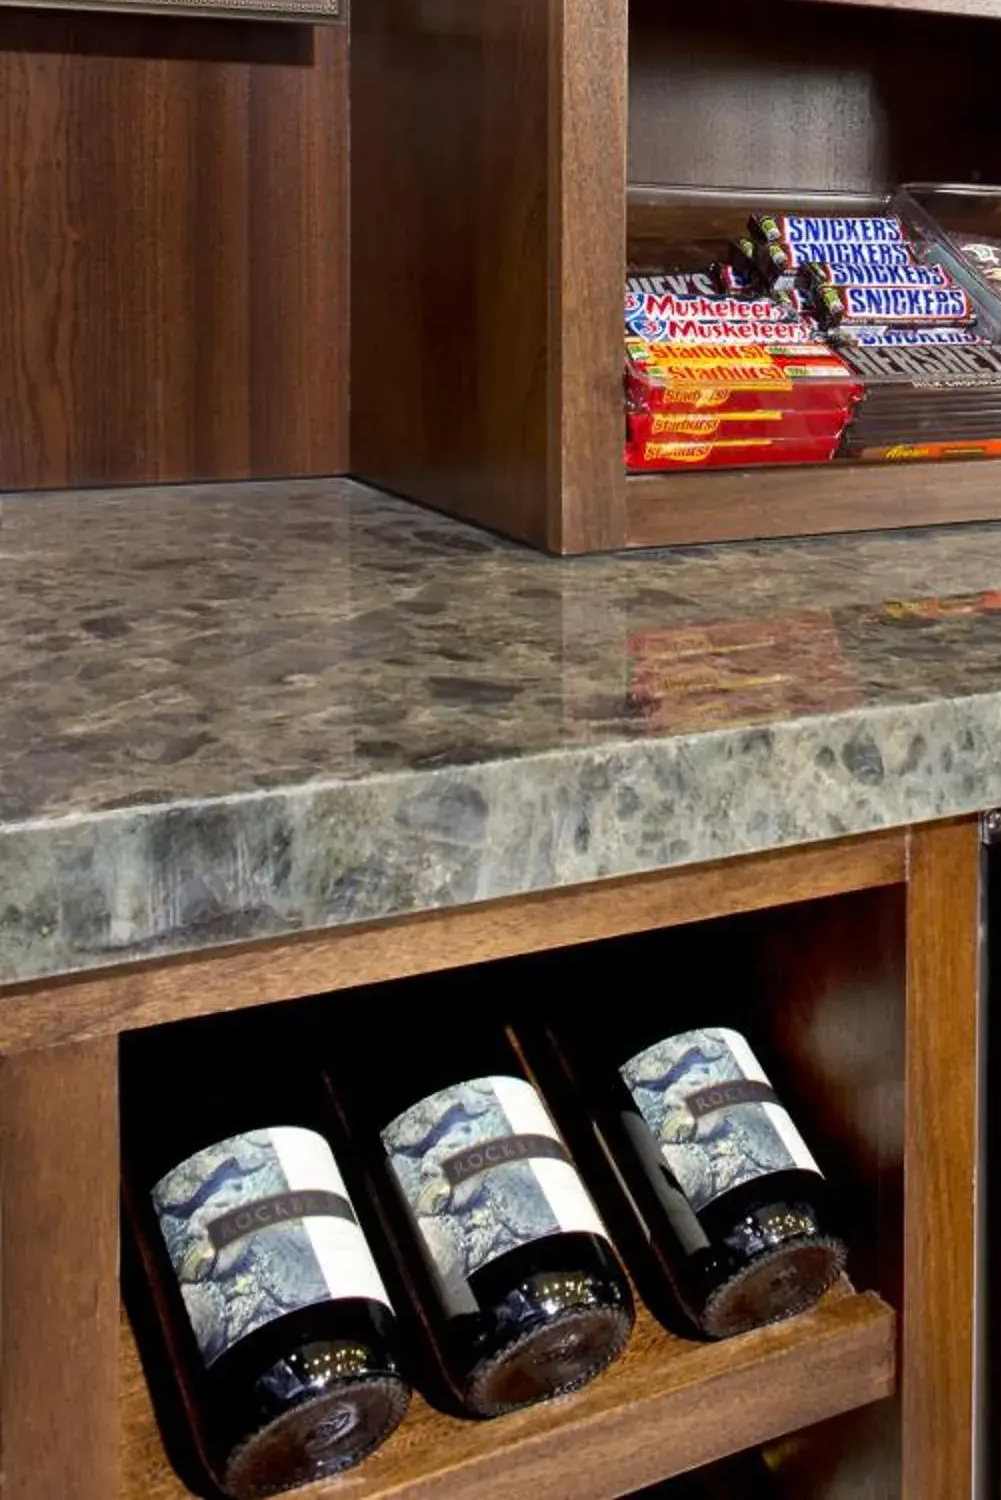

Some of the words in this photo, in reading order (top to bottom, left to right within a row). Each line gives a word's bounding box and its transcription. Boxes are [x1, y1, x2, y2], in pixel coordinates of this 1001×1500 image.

[789, 216, 901, 243] SNICKERS
[792, 242, 910, 265] SNICKERS
[833, 264, 945, 285] SNICKERS
[645, 295, 788, 320] Musketeers
[850, 289, 964, 315] SNICKERS
[668, 320, 810, 339] Musketeers
